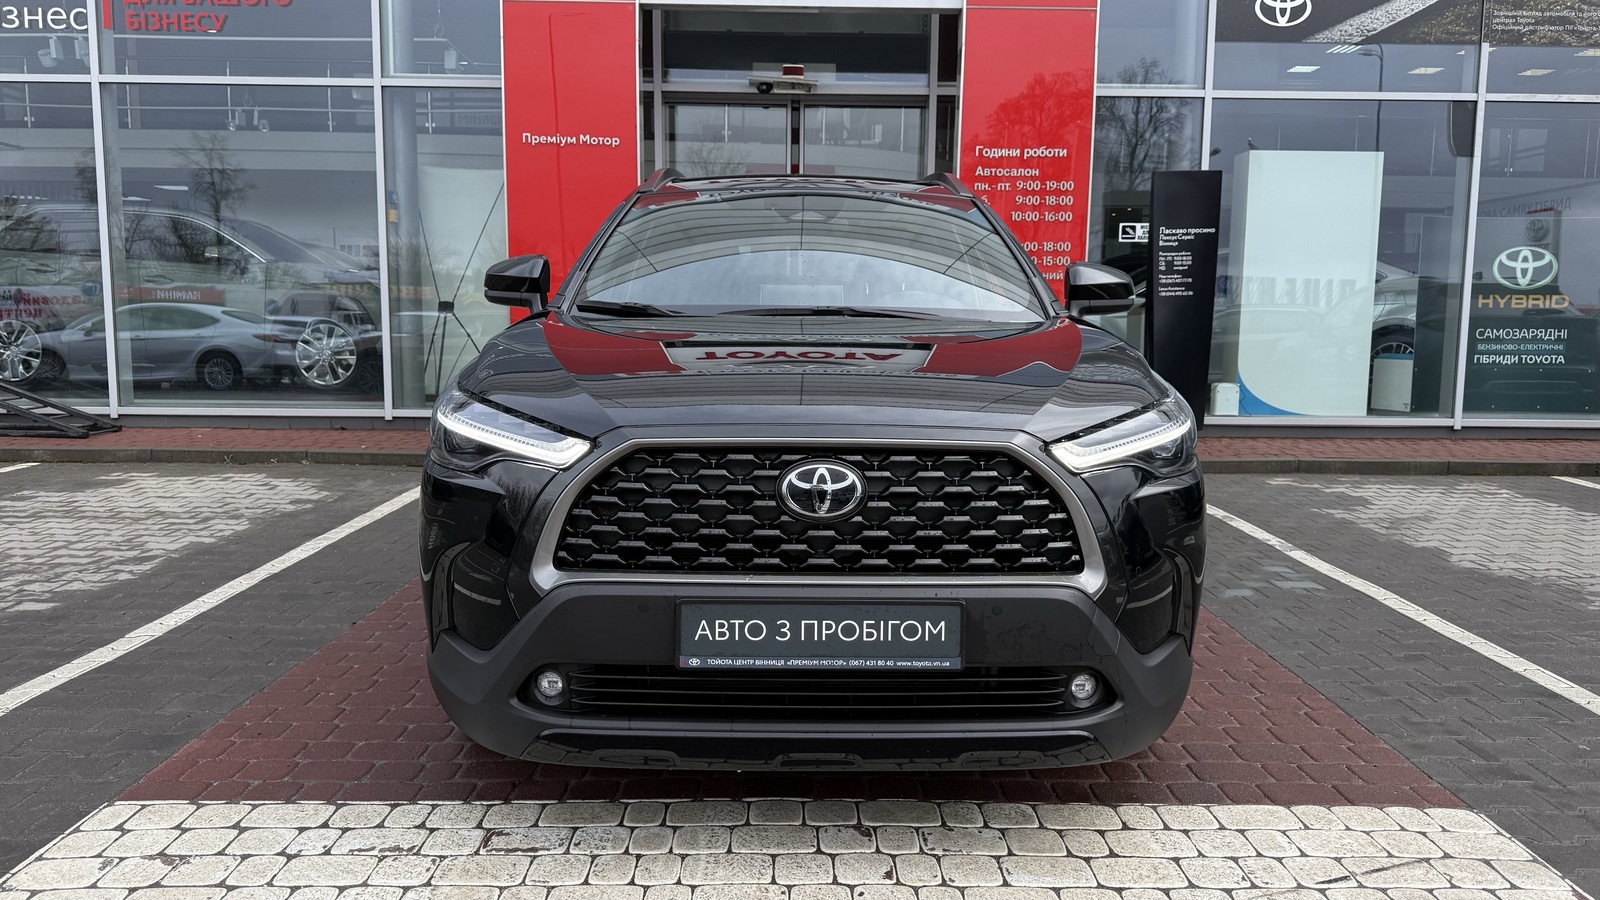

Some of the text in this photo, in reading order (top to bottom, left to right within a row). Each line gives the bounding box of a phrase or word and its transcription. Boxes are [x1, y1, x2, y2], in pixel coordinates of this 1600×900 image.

[124, 11, 227, 32] БІЗНЕСУ
[521, 132, 620, 148] Преміум Мотор
[975, 145, 1068, 160] Години роботи
[975, 165, 1039, 177] Автосалон
[1016, 181, 1074, 191] 9:00-19:00
[1015, 195, 1074, 206] 9:00-18:00
[1010, 211, 1073, 222] 10:00-16:00
[1160, 227, 1187, 235] Ласкаво
[1477, 294, 1570, 309] HYBRID
[1475, 328, 1568, 341] САМОЗАРЯДНІ
[1477, 343, 1564, 351] БЕНЗИНОВО-ЕЛЕКТРИЧНІ
[1474, 354, 1565, 365] ГІБРИДИ TOYOTA
[694, 619, 767, 642] АВТО
[800, 619, 947, 642] ПРОБІГОМ
[706, 657, 733, 666] ТОЙОТА
[733, 658, 755, 666] ЦЕНТР
[755, 658, 785, 667] ВІННИЦЯ
[848, 658, 865, 667] (067)
[865, 658, 877, 667] 431
[877, 658, 886, 667] 80
[886, 658, 894, 667] 40
[895, 659, 950, 668] www.toyota.vn.ua
